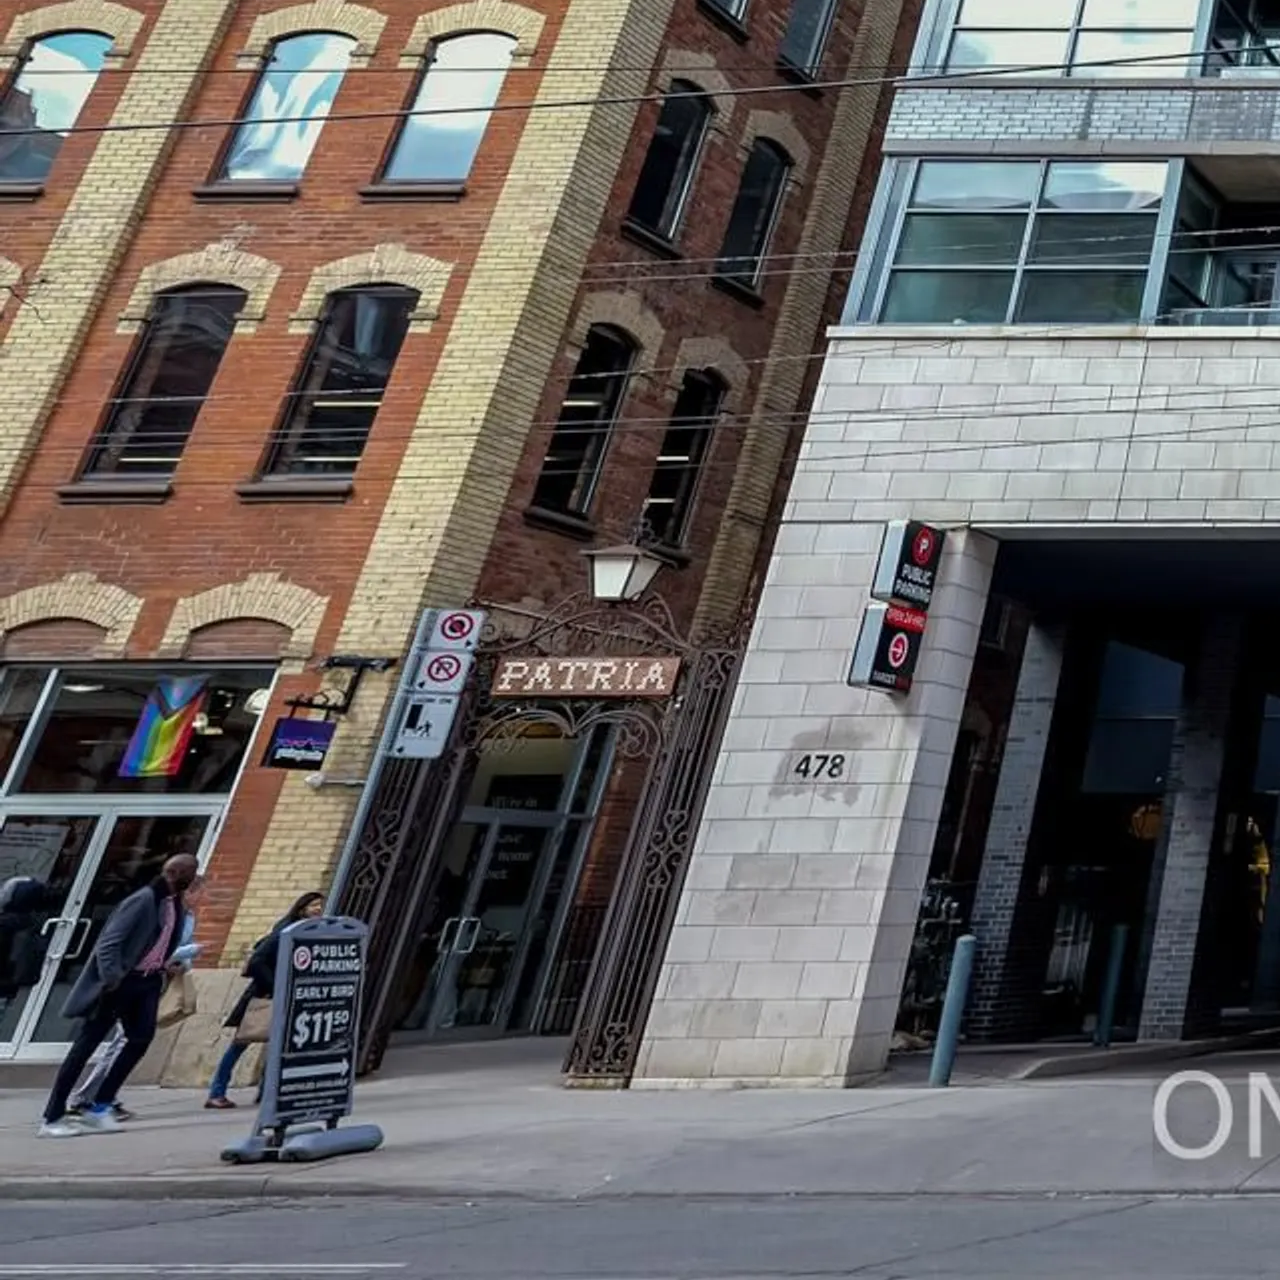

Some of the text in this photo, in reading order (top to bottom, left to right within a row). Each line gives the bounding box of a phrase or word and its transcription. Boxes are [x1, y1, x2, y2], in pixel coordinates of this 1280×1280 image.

[497, 662, 666, 690] PATRIA
[794, 754, 845, 778] 478
[311, 944, 357, 957] PUBLIC
[311, 958, 361, 973] PARKING
[295, 984, 355, 1000] EARLY BIRD
